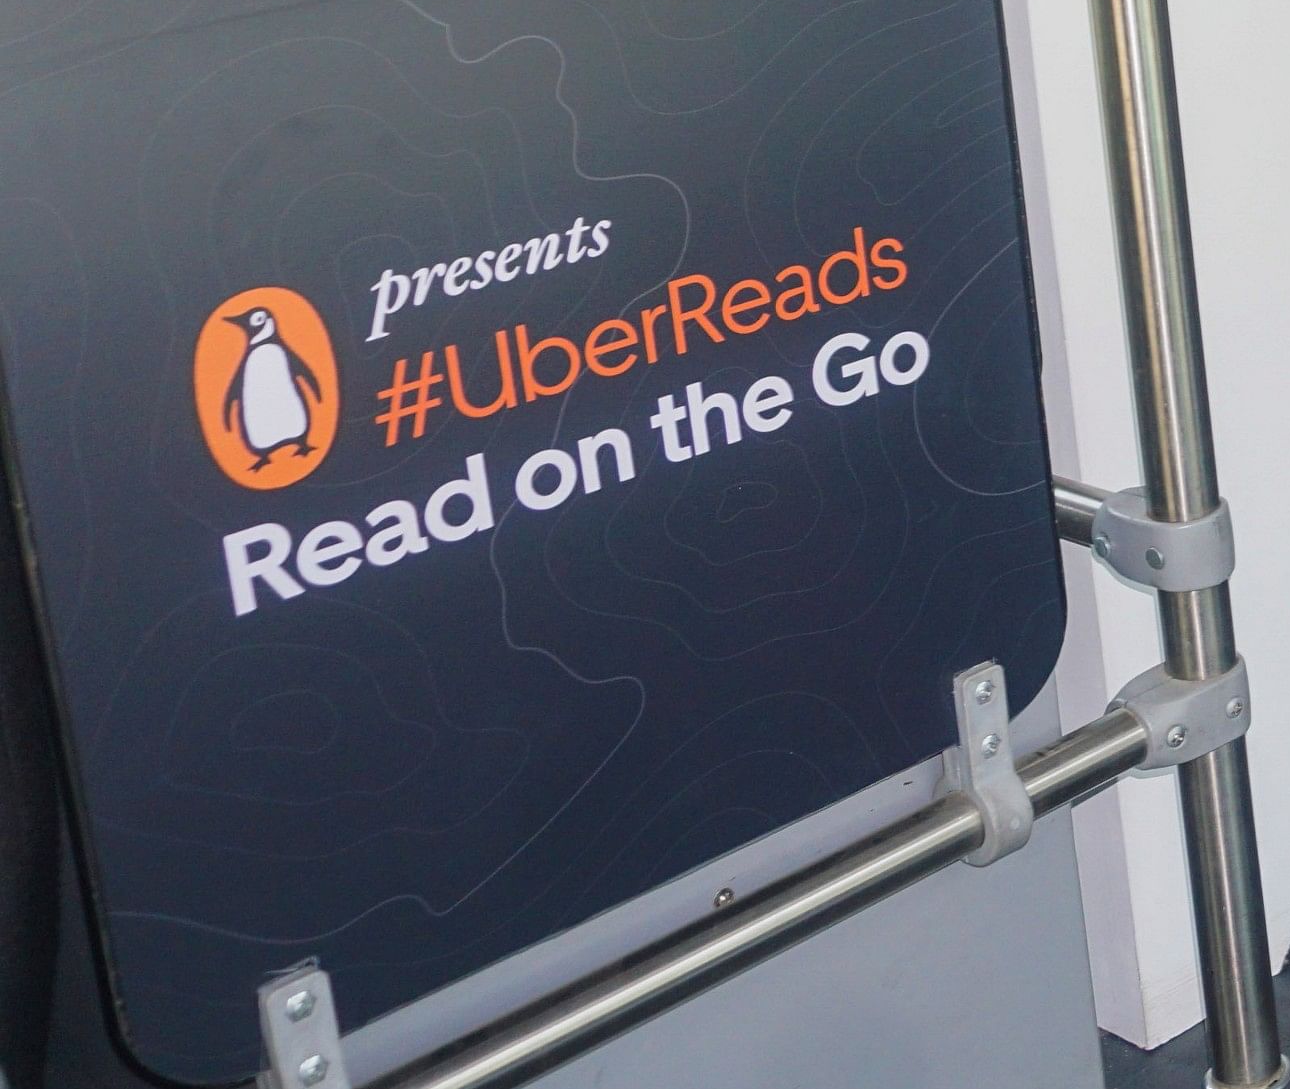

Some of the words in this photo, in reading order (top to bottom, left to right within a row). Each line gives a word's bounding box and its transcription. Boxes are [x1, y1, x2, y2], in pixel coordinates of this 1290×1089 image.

[366, 217, 612, 342] presents
[374, 226, 909, 447] #UberReads
[222, 452, 495, 617] Read
[514, 427, 636, 511] on
[650, 375, 795, 463] the
[811, 330, 931, 407] Go
